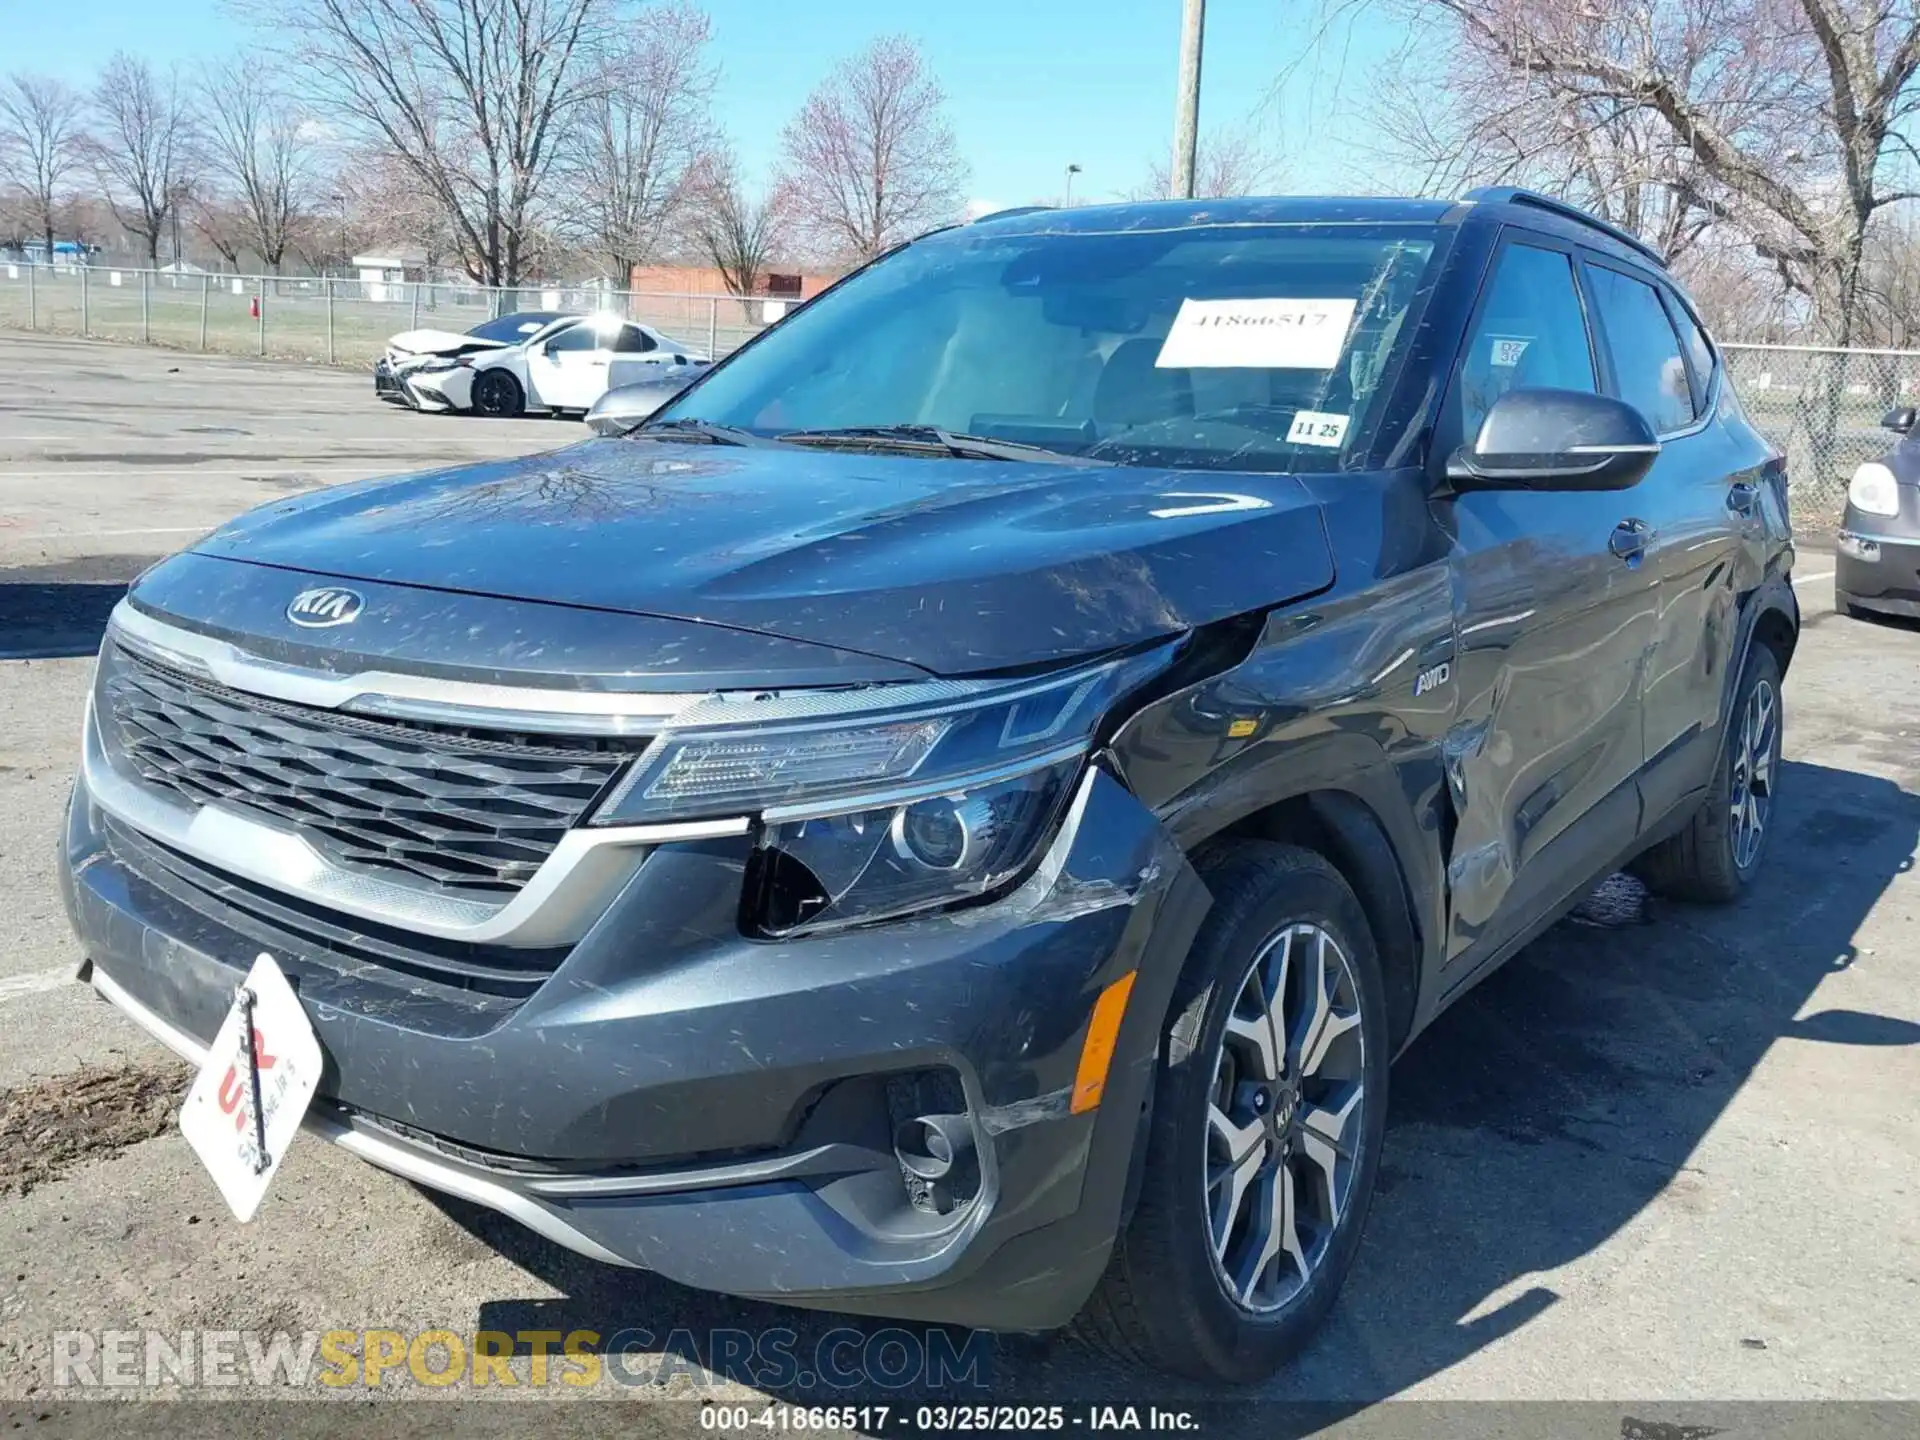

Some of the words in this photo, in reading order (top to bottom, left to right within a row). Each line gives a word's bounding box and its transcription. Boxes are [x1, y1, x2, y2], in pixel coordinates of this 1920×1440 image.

[1295, 421, 1314, 436] 11
[1317, 423, 1339, 438] 25
[293, 590, 351, 619] KIA
[1415, 662, 1450, 697] AWD
